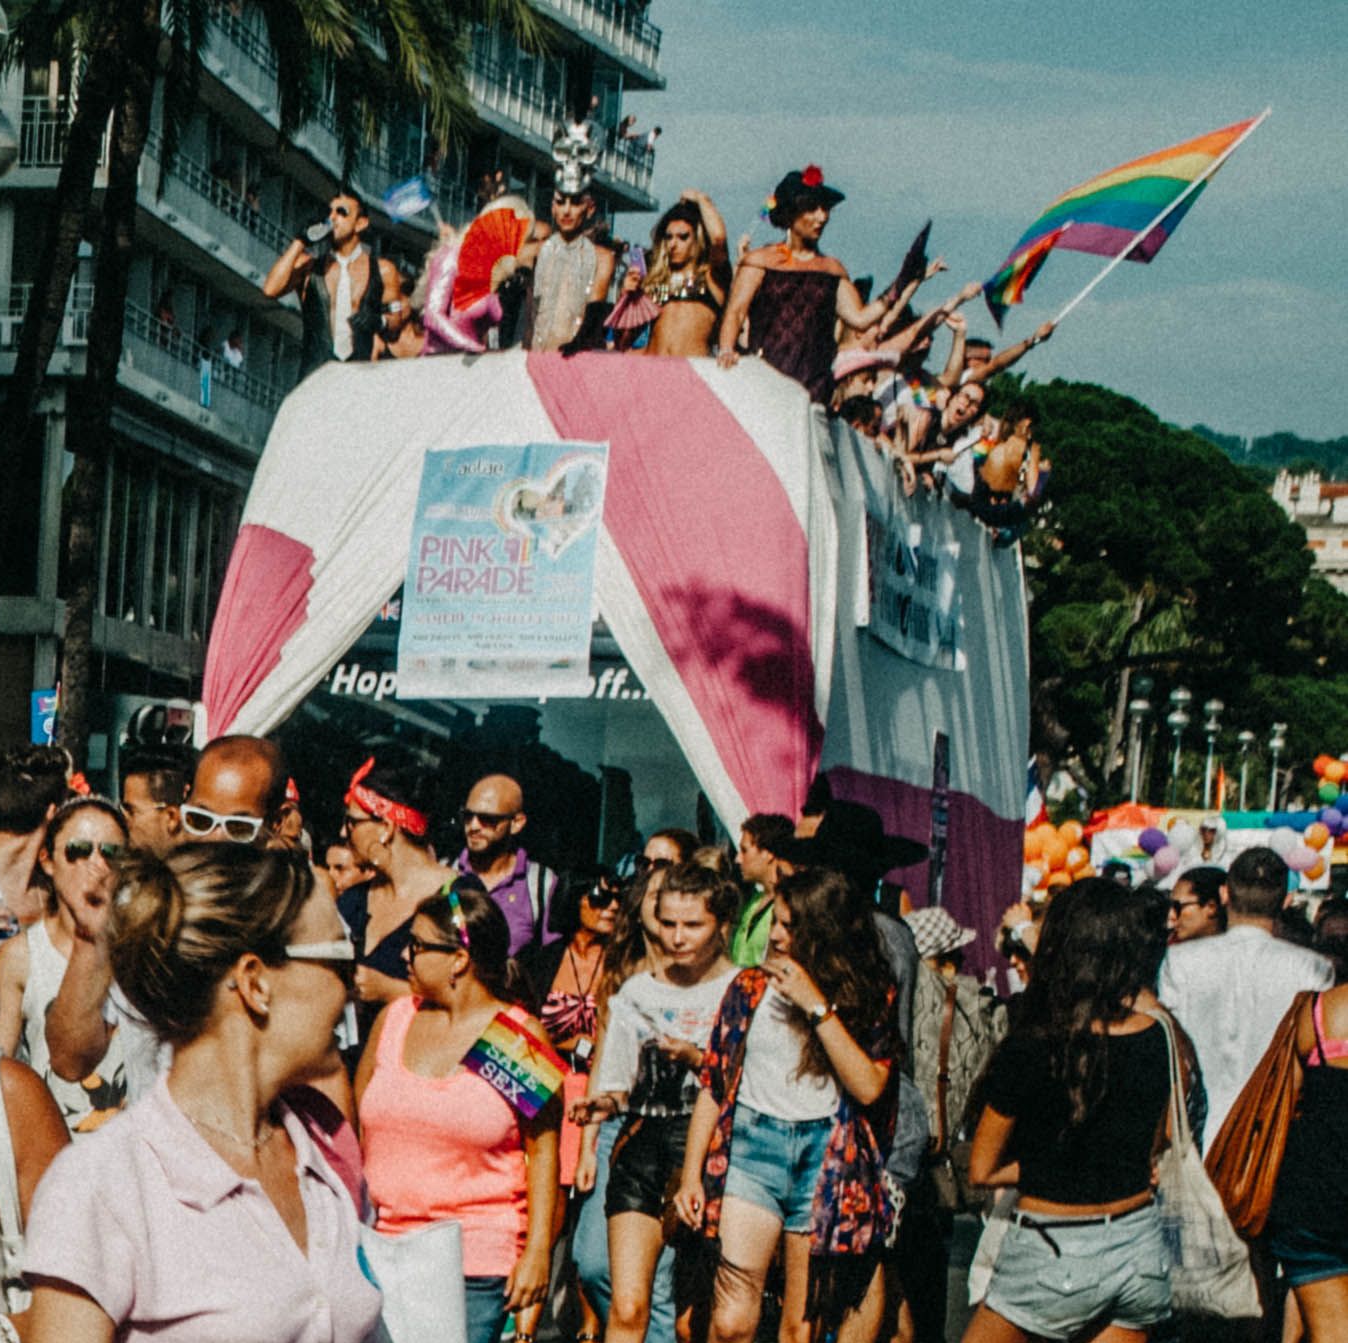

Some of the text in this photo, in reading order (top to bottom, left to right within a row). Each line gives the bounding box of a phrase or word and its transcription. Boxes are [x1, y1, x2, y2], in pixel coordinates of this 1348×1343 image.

[420, 536, 496, 564] PINK
[417, 565, 536, 594] PARADE
[330, 665, 650, 701] Hop ff...
[479, 1060, 526, 1104] SEX
[485, 1043, 541, 1092] SAFE
